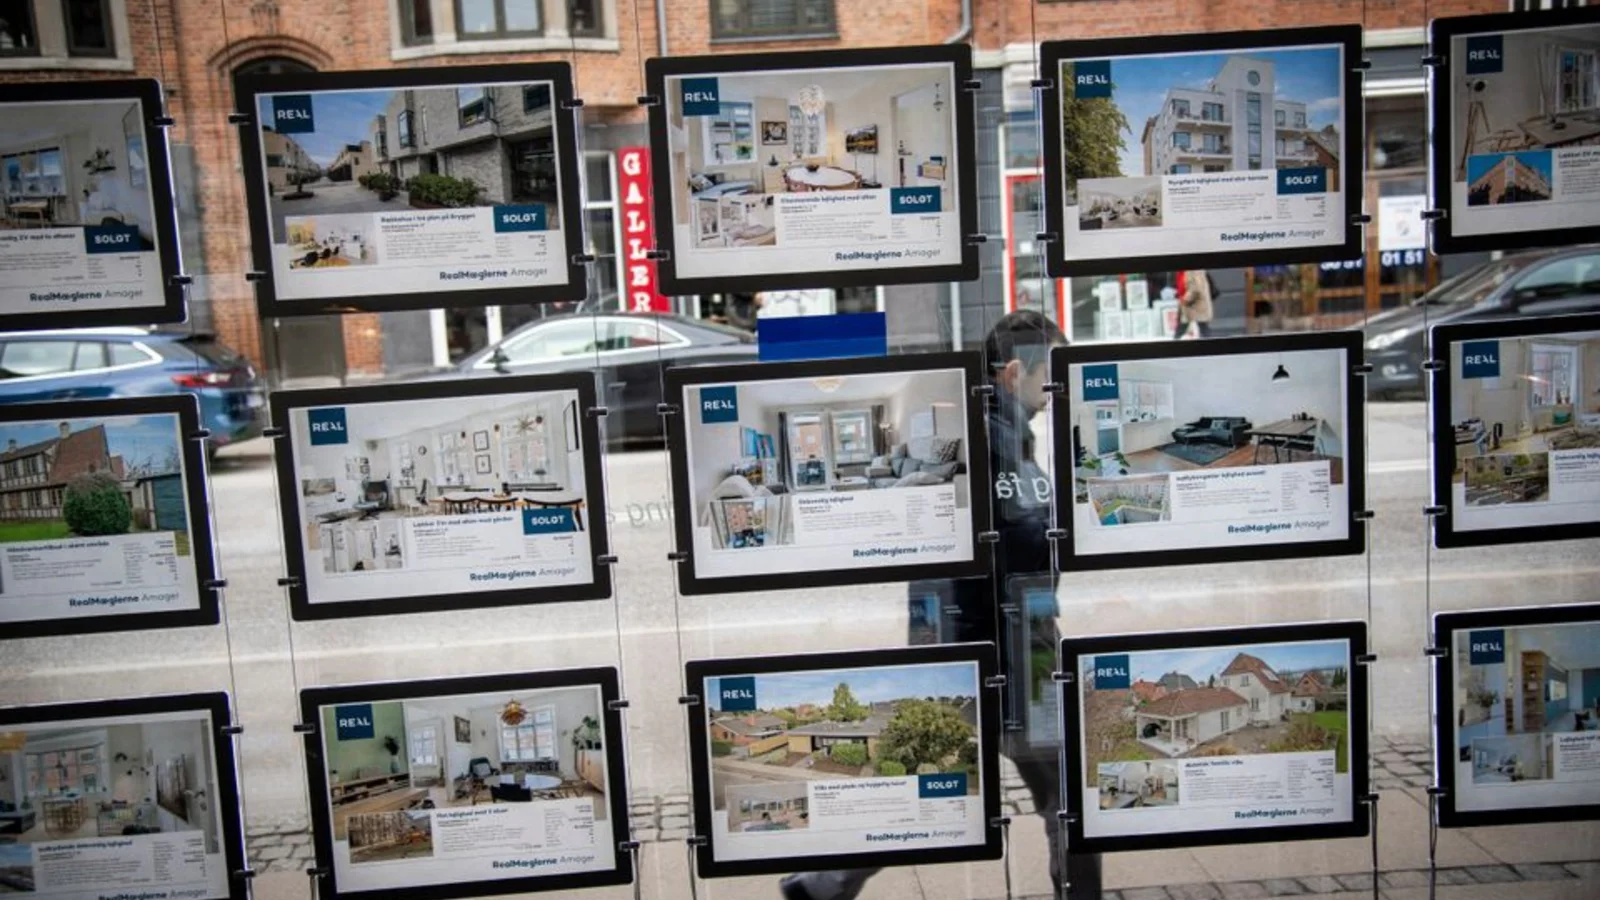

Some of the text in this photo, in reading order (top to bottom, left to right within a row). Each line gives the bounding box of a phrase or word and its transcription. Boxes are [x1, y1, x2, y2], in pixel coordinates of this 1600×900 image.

[1284, 175, 1318, 186] SOLGT
[899, 195, 933, 205] SOLGT
[502, 213, 538, 224] SOLGT
[94, 233, 131, 245] SOLGT
[1220, 230, 1286, 242] RealMæglerne
[835, 250, 902, 261] RealMæglerne
[1381, 252, 1401, 266] 01
[439, 269, 508, 281] RealMæglerne
[29, 291, 102, 303] RealMæglerne
[531, 515, 565, 526] SOLGT
[1228, 521, 1292, 534] RealMæglerne
[853, 546, 918, 557] RealMæglerne
[469, 568, 536, 581] RealMæglerne
[69, 595, 139, 607] RealMæglerne
[926, 780, 959, 790] SOLGT
[1234, 808, 1298, 819] RealMæglerne
[866, 830, 930, 842] RealMæglerne
[493, 856, 557, 868] RealMæglerne
